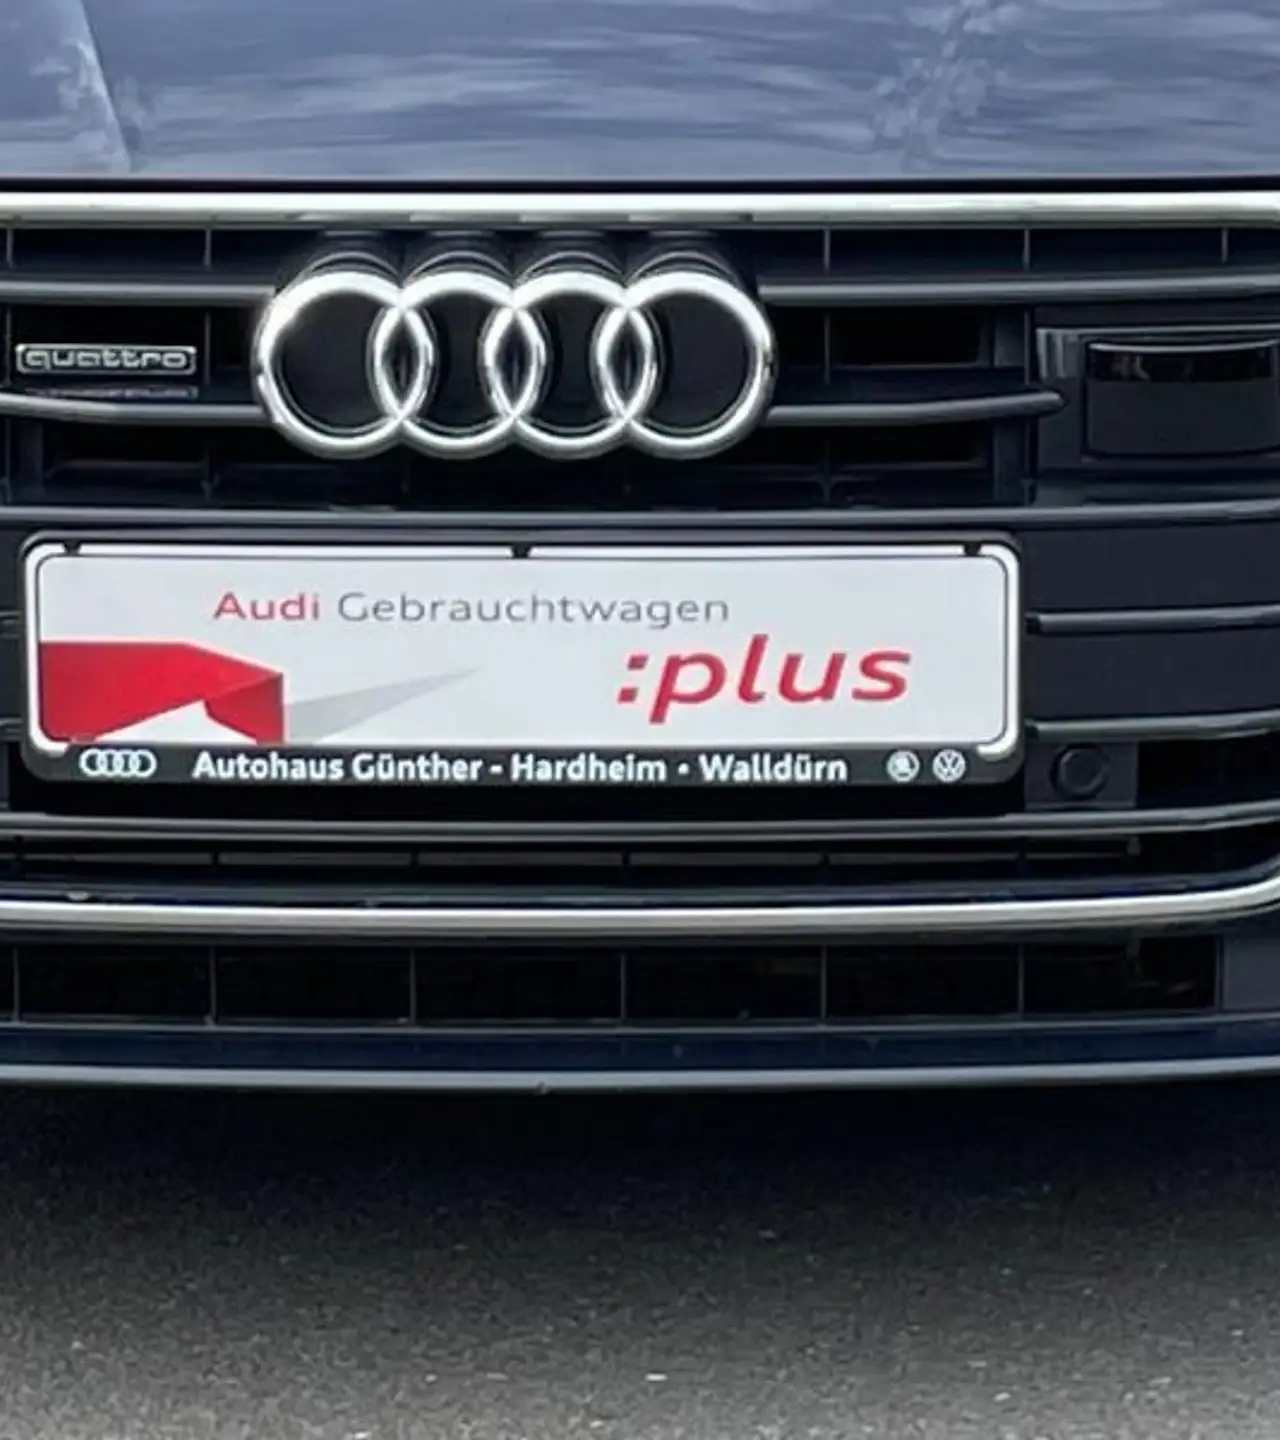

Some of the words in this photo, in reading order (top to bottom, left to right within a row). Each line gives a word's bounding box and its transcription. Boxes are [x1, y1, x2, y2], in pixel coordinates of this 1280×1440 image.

[25, 349, 187, 370] quattro
[213, 591, 320, 621] Audi
[338, 592, 729, 629] Gebrauchtwagen
[617, 634, 911, 724] :plus
[192, 750, 344, 781] Autohaus
[351, 752, 484, 781] Günther
[510, 752, 666, 782] Hardheim
[698, 752, 848, 782] Walldürn
